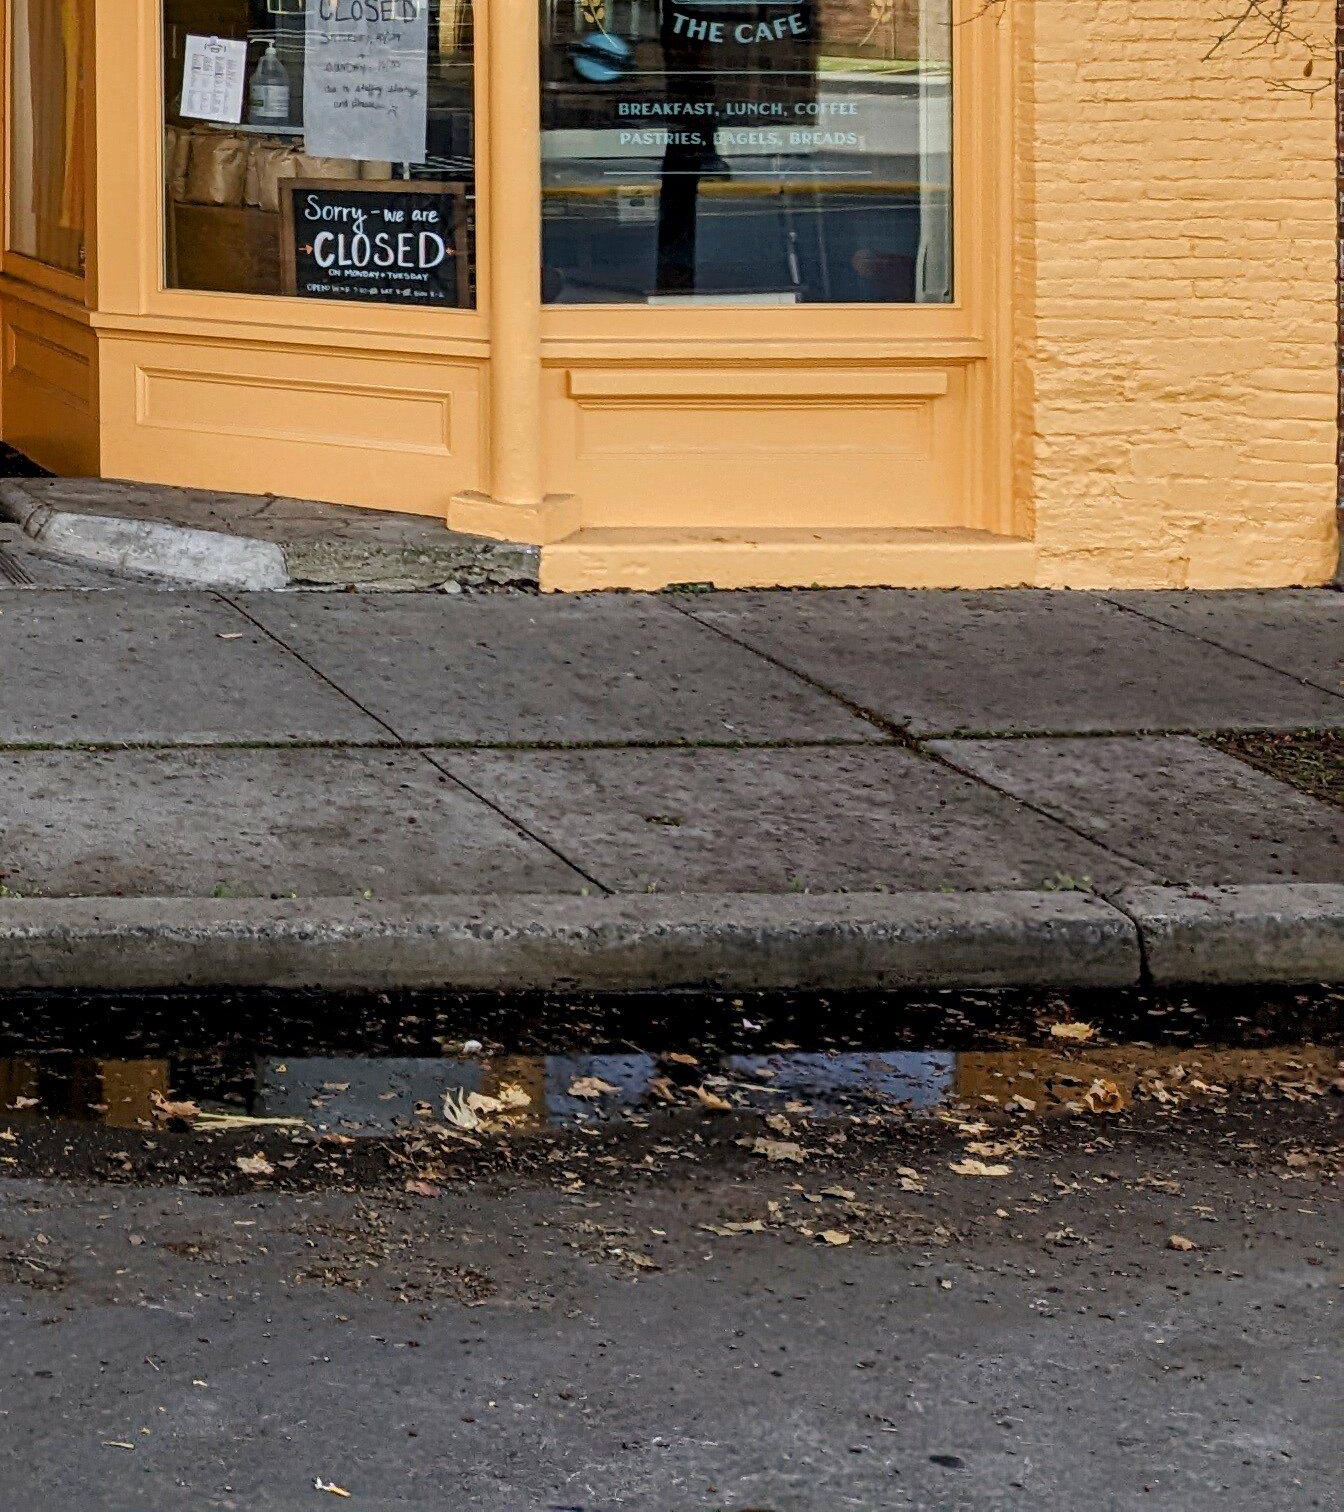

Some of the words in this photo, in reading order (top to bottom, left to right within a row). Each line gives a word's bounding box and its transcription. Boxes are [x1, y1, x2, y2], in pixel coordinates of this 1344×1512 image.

[672, 13, 723, 43] THE
[734, 13, 807, 44] CAFE
[618, 102, 720, 117] BREAKFAST,
[726, 102, 788, 117] LUNCH,
[794, 102, 859, 116] COFFEE
[619, 132, 707, 146] PASTRIES,
[789, 132, 858, 146] BREADS
[304, 194, 368, 234] Sorry
[383, 208, 405, 223] we
[411, 209, 440, 223] are
[313, 231, 446, 269] CLOSED
[388, 271, 430, 281] TUESDAY
